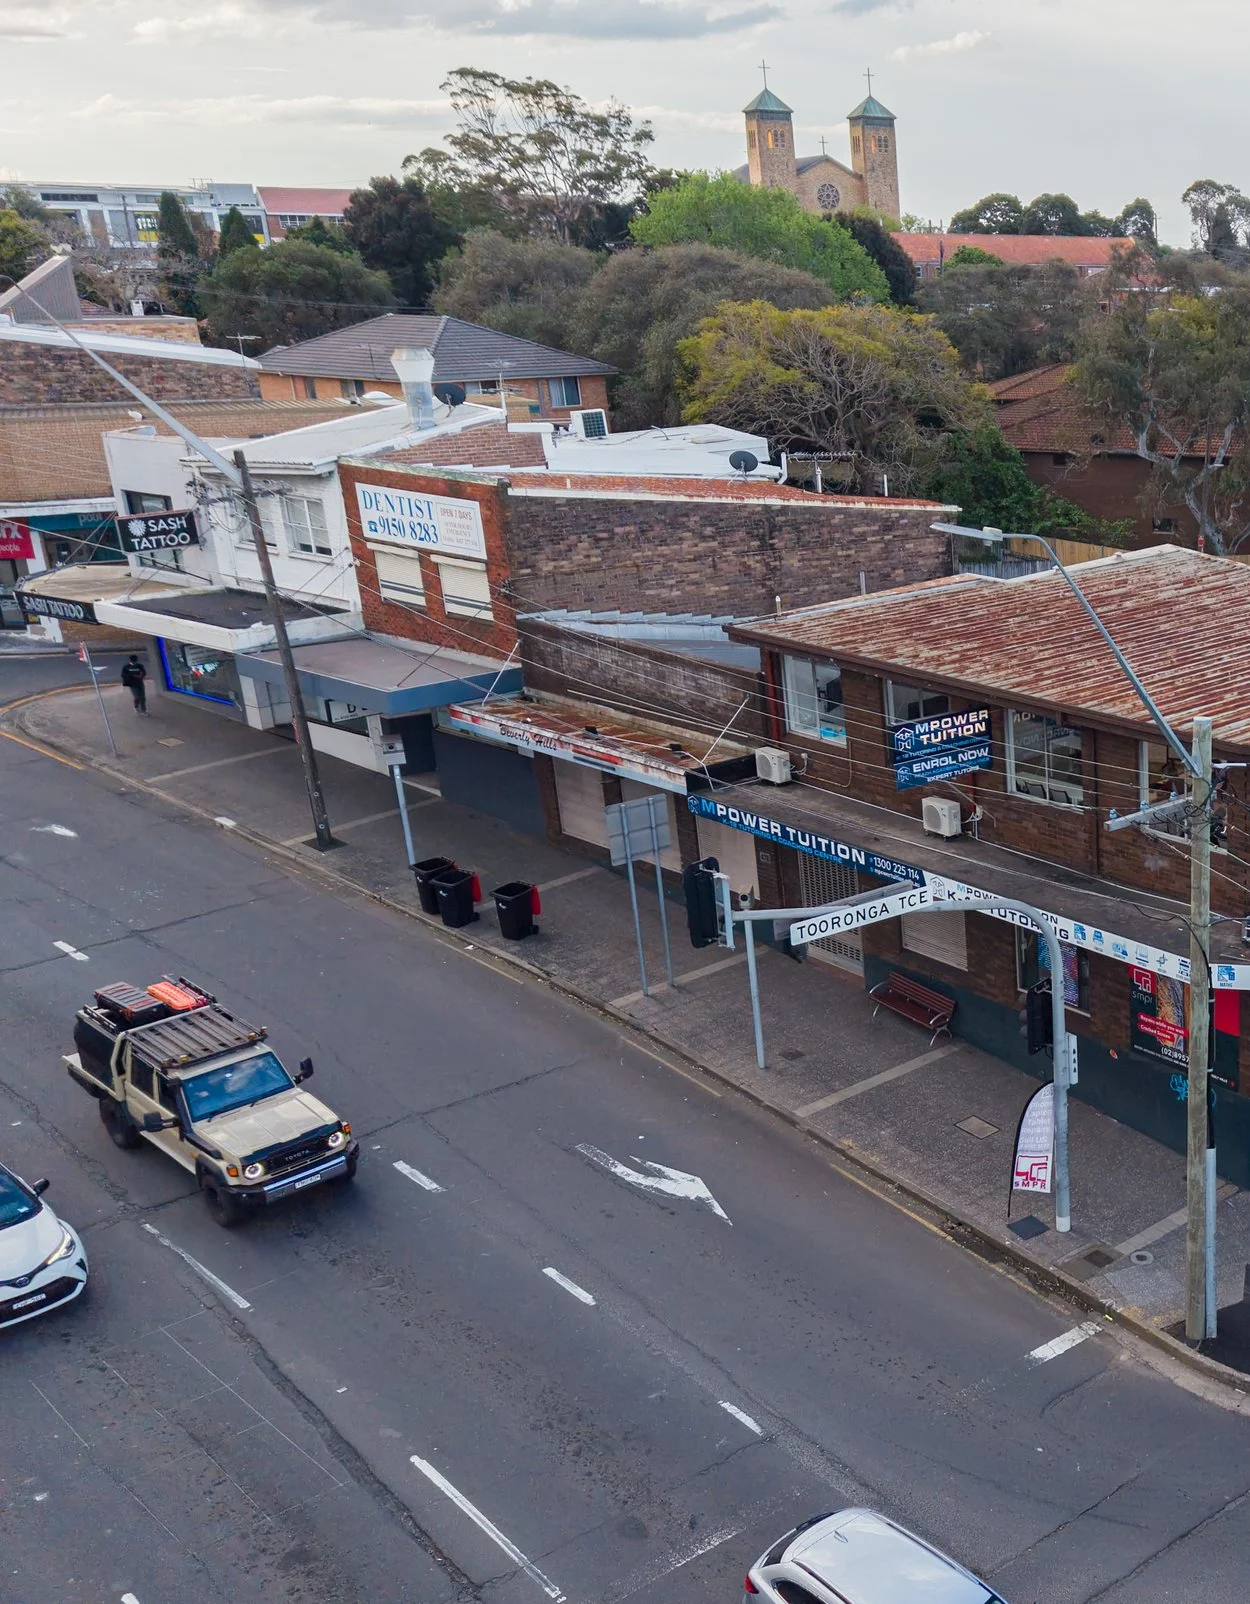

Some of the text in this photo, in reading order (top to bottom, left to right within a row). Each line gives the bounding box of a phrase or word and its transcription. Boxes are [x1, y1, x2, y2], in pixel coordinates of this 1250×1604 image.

[362, 490, 433, 520] DENTIST
[148, 517, 187, 532] SASH
[378, 516, 406, 538] 9150
[409, 520, 439, 543] 8283
[131, 532, 191, 551] TATTOO
[23, 596, 84, 619] SASH TATTOO
[916, 710, 989, 734] MPOWER
[920, 722, 986, 744] TUITION
[913, 747, 989, 773] ENROL NOW
[927, 772, 953, 782] EXPERT
[701, 799, 866, 865] MPOWER TUITION
[738, 824, 771, 840] TUTORING
[778, 836, 813, 855] COACHING
[814, 846, 843, 864] CENTRE
[873, 857, 920, 880] 1300 225 114
[797, 890, 928, 939] TOORONGA TCE
[285, 1149, 309, 1161] TOYOTA
[1015, 1181, 1046, 1190] SMPR
